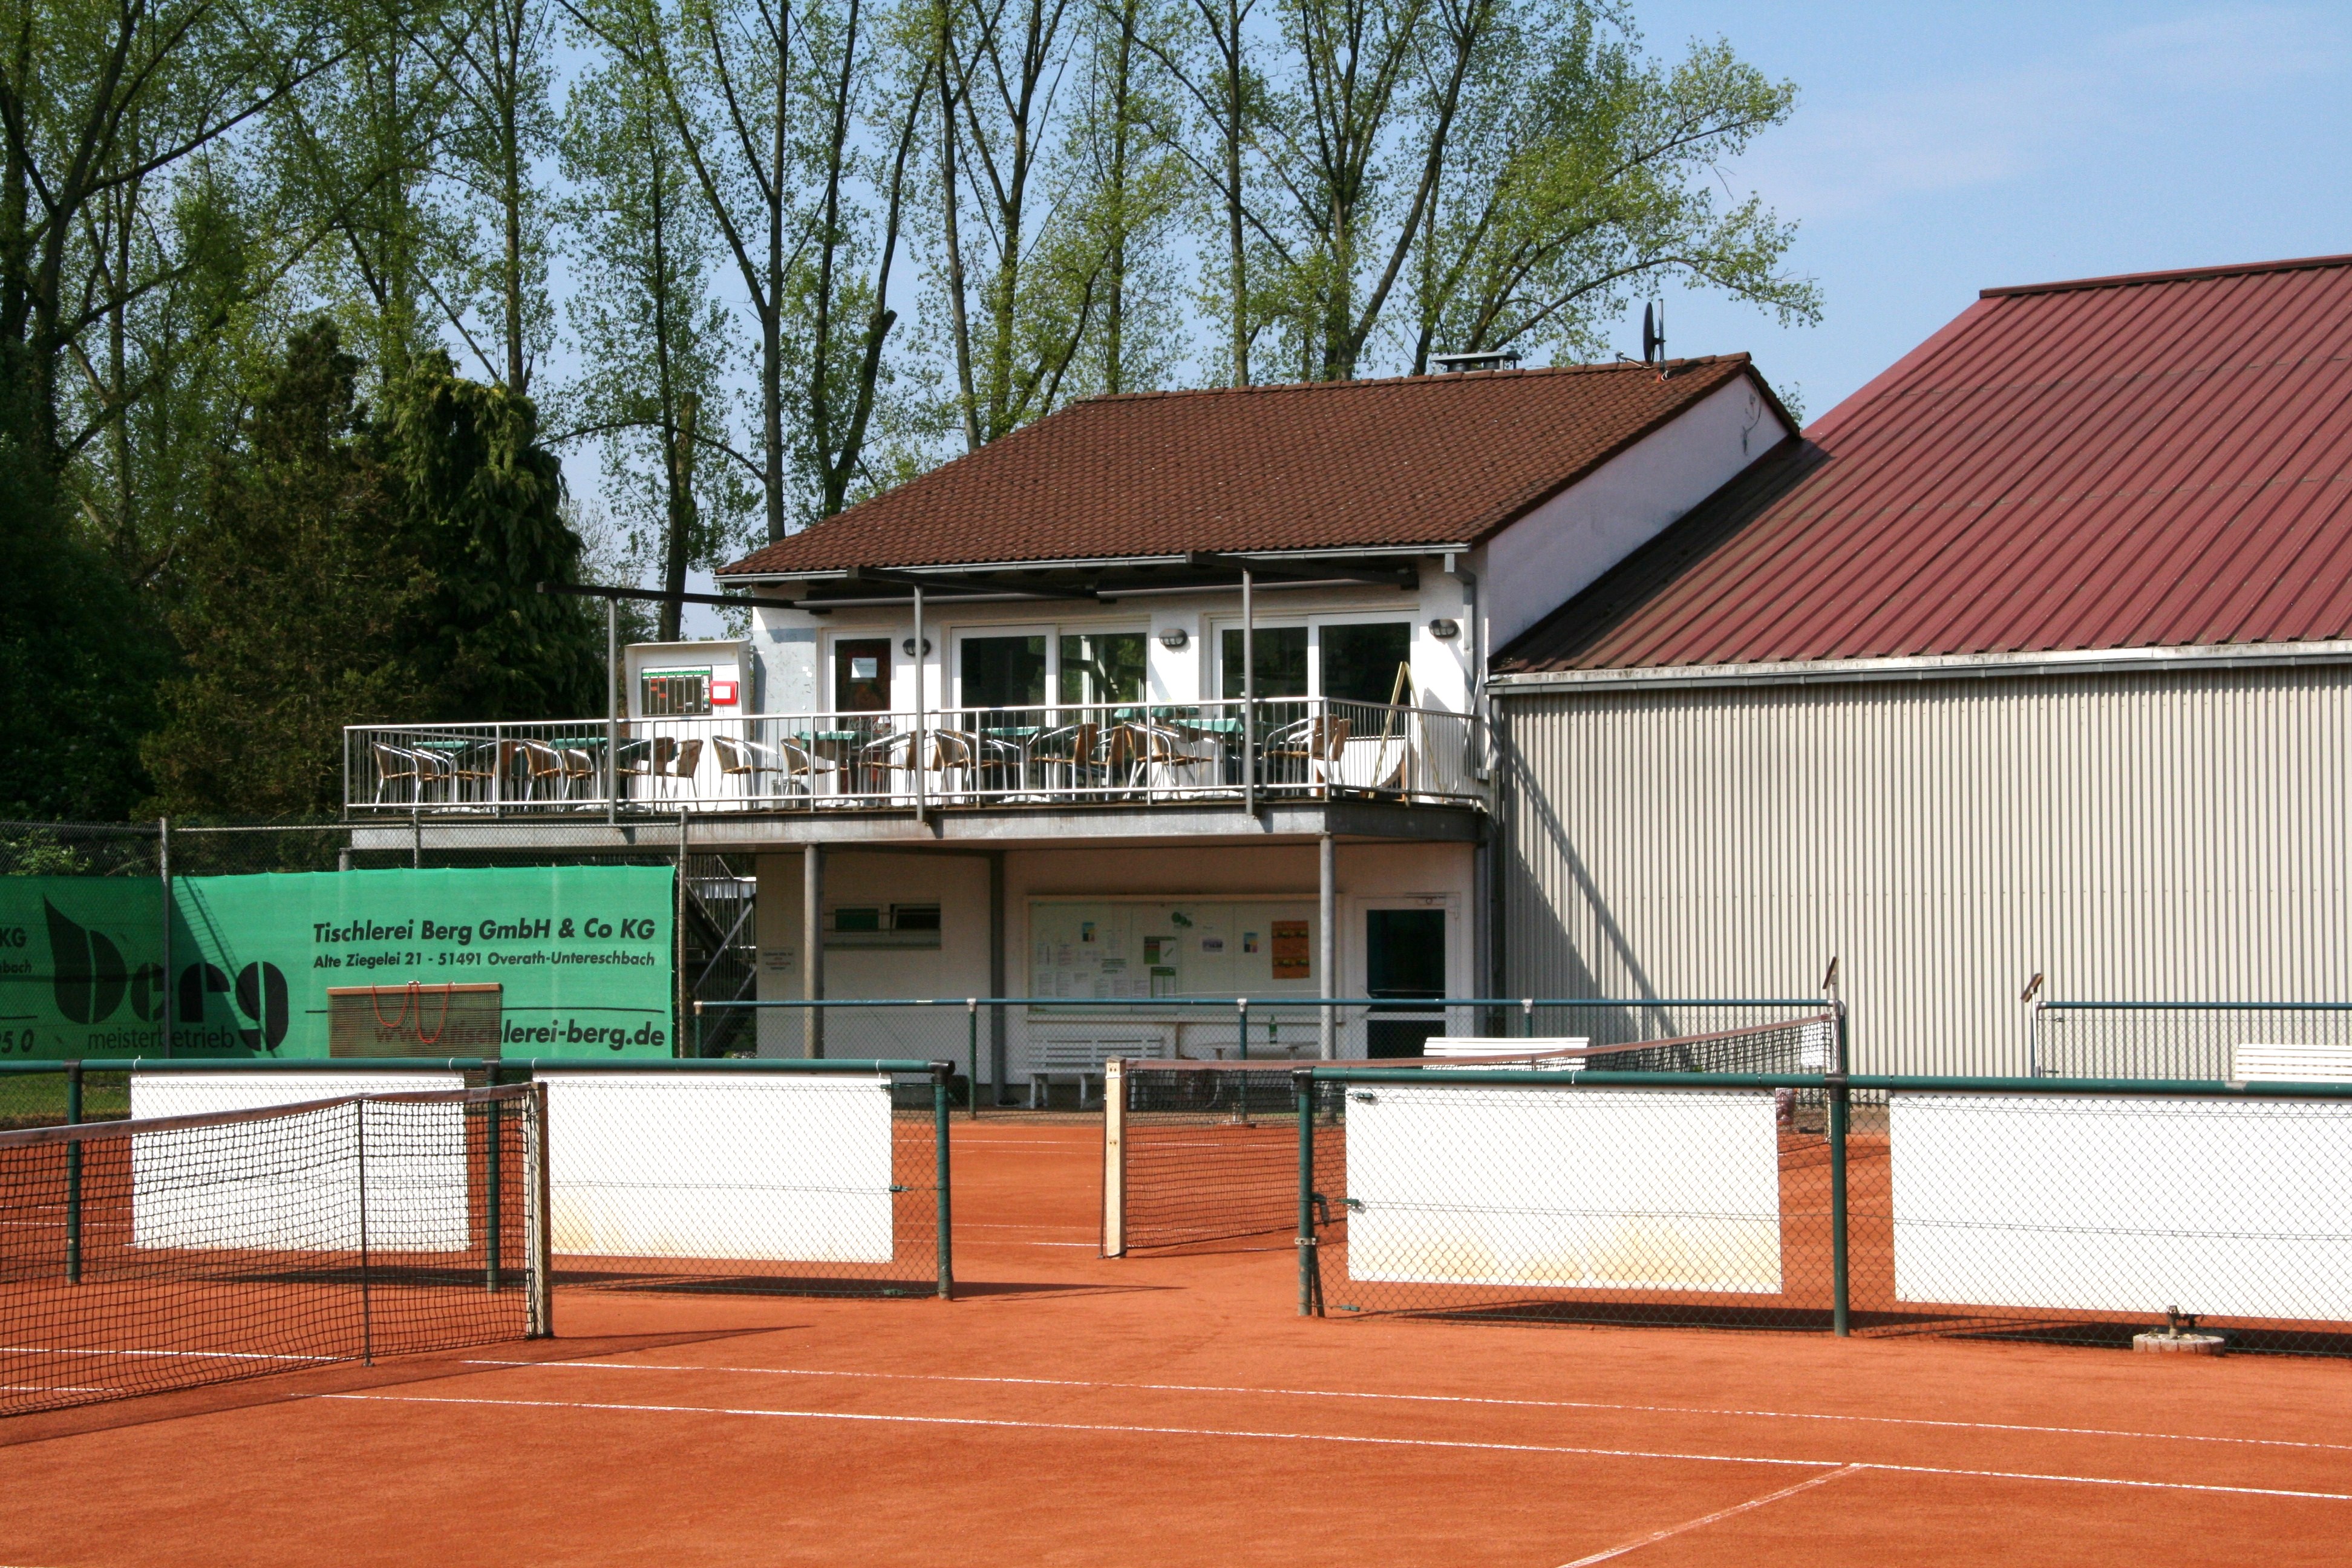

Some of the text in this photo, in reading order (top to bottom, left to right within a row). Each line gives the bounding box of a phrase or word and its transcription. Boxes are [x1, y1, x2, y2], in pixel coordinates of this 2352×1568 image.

[313, 918, 655, 946] Tischlerei Berg GmbH & Co KG
[313, 954, 341, 969] Alte
[345, 952, 400, 969] Ziegelei
[405, 952, 422, 965] 21
[438, 952, 481, 965] 51491
[488, 950, 655, 965] Overath-Untereschbach
[88, 1025, 235, 1050] meisterbetrieb
